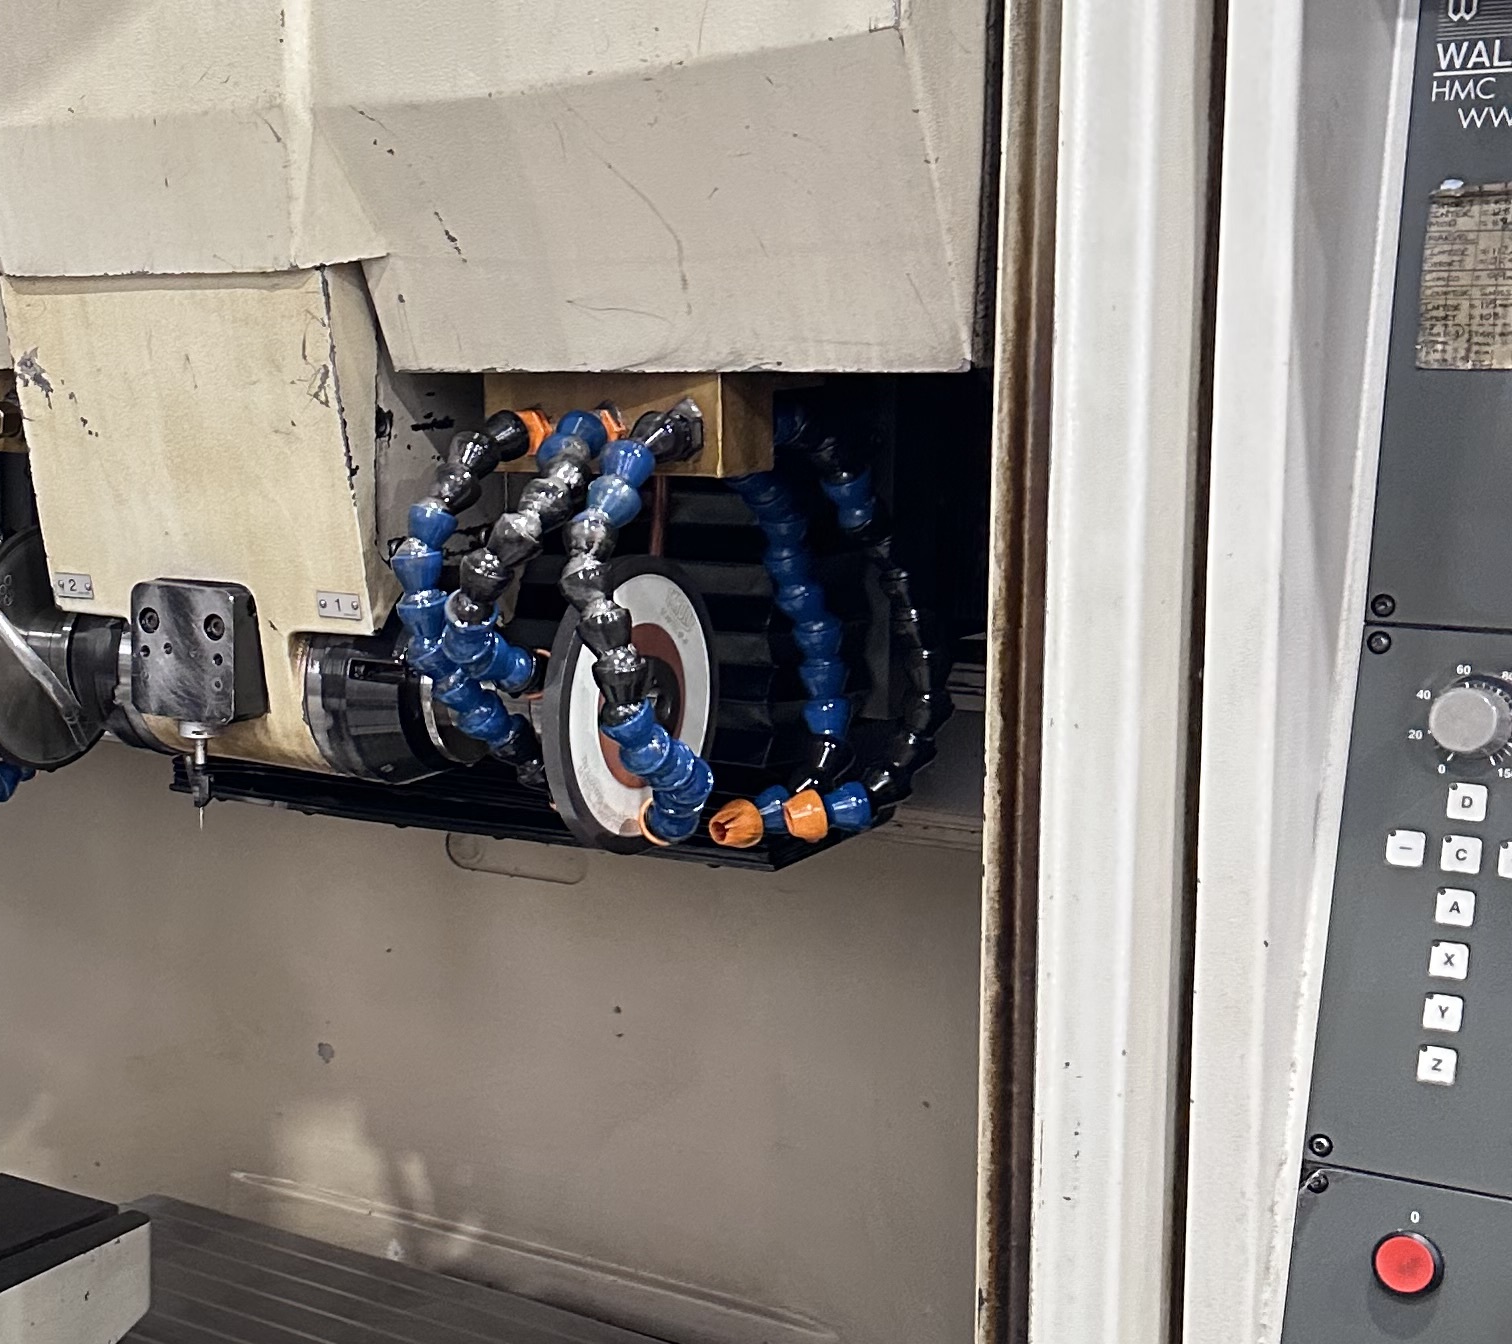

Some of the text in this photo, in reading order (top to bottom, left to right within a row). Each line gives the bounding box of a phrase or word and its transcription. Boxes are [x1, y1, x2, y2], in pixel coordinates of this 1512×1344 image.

[1437, 39, 1512, 70] WAL
[1431, 76, 1496, 102] HMC
[68, 578, 78, 592] 2
[334, 598, 342, 613] 1
[1456, 664, 1472, 675] 60
[1416, 689, 1432, 700] 40
[1408, 729, 1423, 740] 20
[1437, 763, 1446, 774] 0
[1461, 795, 1473, 809] D
[1455, 848, 1468, 861] C
[1449, 900, 1461, 914] A
[1443, 952, 1455, 967] X
[1438, 1004, 1449, 1019] Y
[1431, 1057, 1443, 1072] Z
